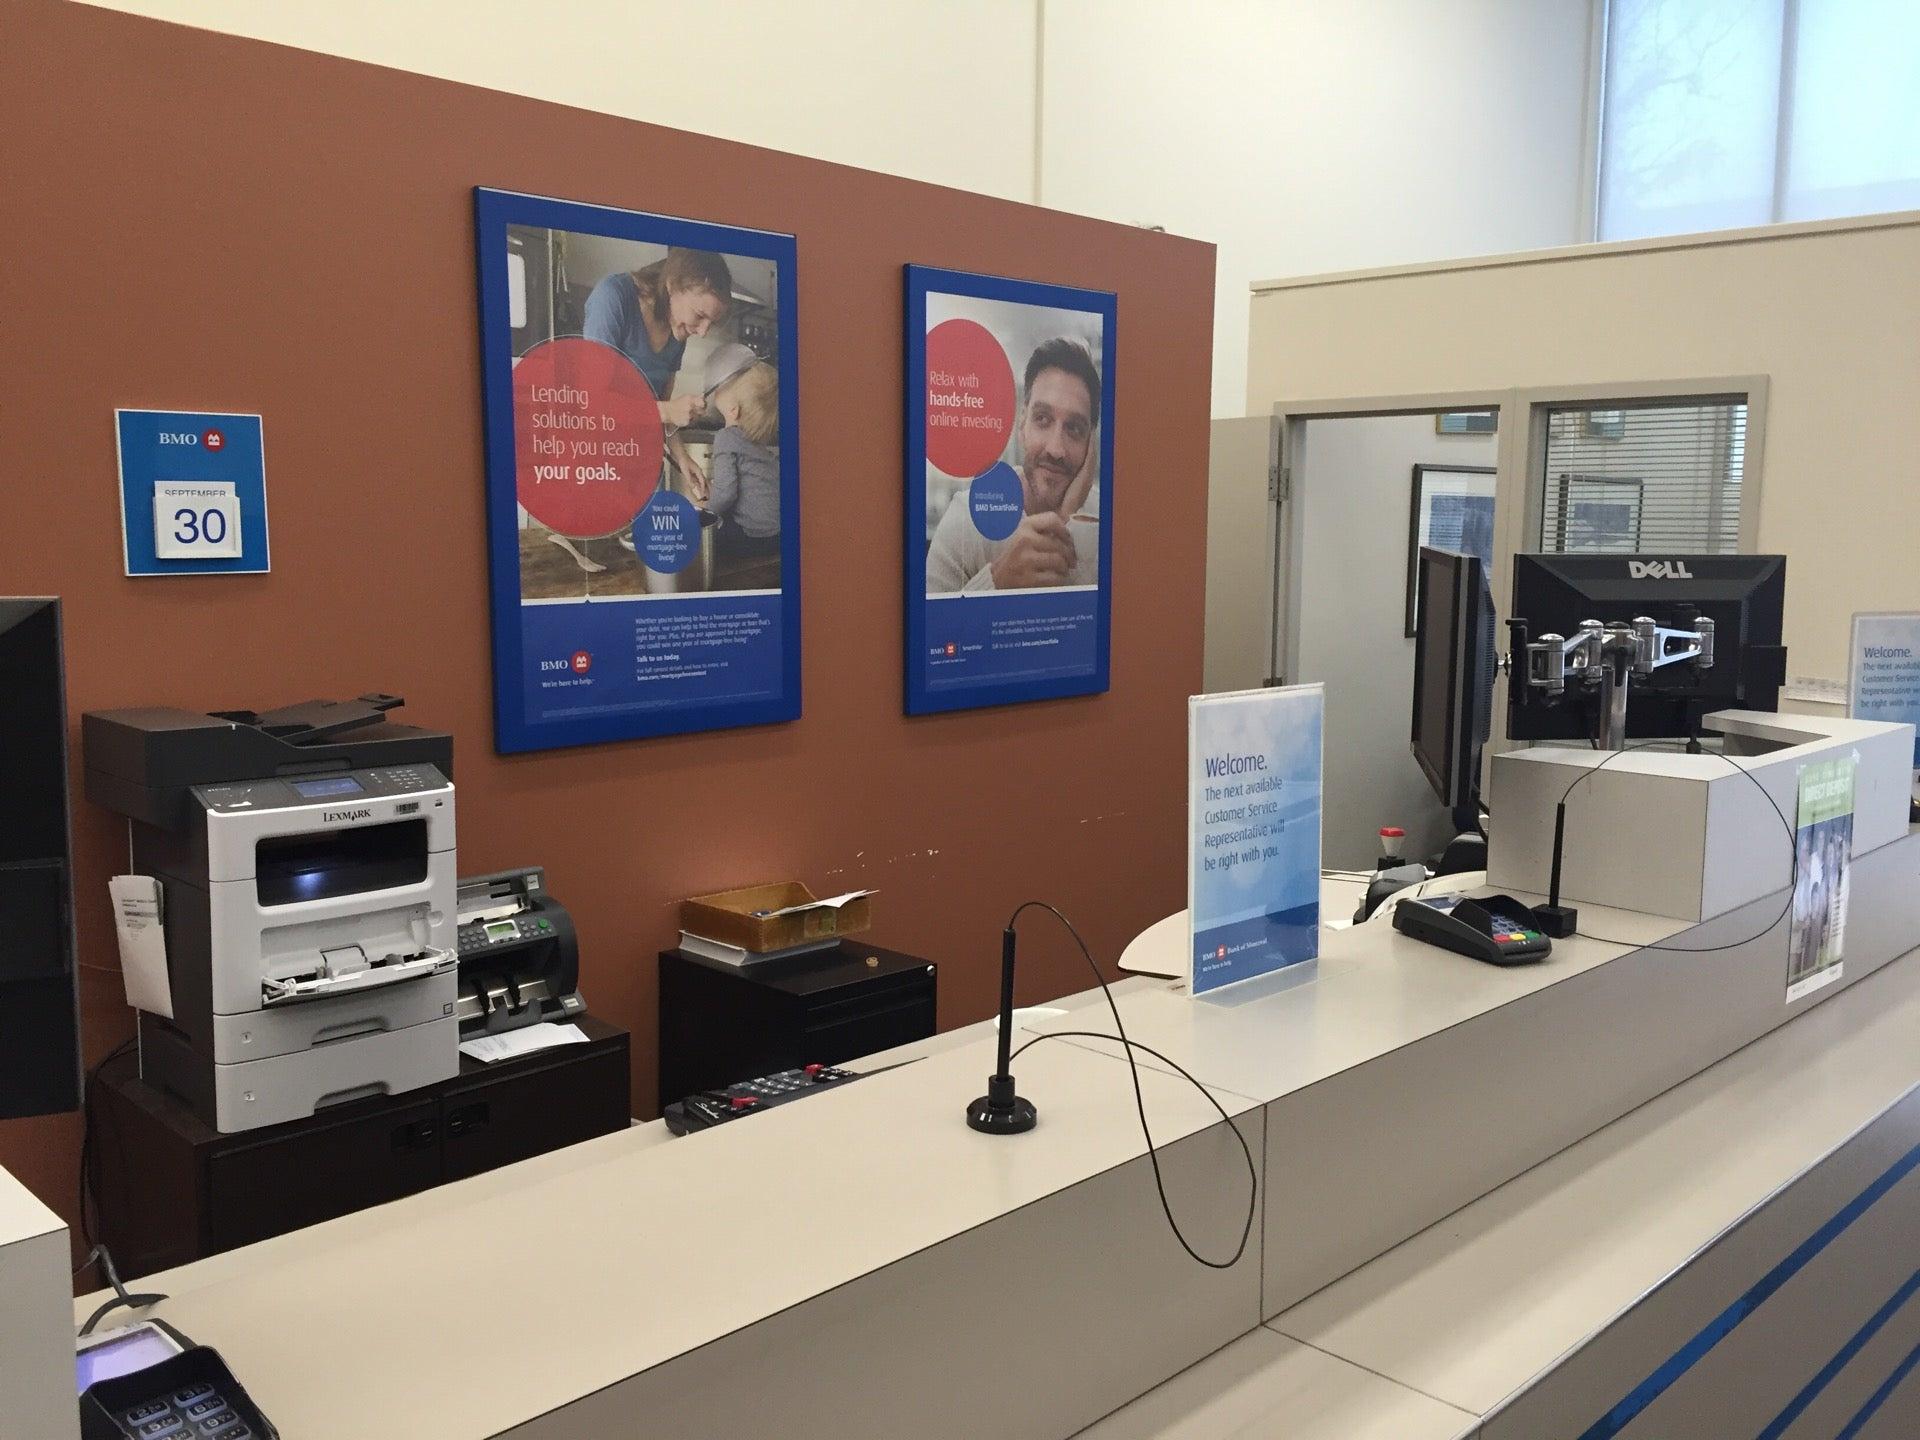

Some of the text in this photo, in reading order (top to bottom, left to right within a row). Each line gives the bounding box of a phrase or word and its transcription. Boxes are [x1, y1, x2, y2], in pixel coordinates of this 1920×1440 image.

[930, 371, 979, 388] Relax with
[532, 385, 588, 409] Lending
[930, 390, 984, 408] hands-free
[533, 410, 615, 431] solutions to
[930, 412, 1003, 432] online investing.
[159, 433, 197, 445] BMO
[534, 434, 639, 459] help you reach
[534, 462, 621, 484] your goals.
[990, 504, 1019, 512] SmartFolio
[174, 509, 226, 543] 30
[652, 516, 680, 530] WIN
[1628, 560, 1693, 579] DELL
[1864, 646, 1912, 658] Welcome.
[541, 660, 568, 670] BMO
[1863, 662, 1875, 670] The
[1206, 753, 1268, 778] Welcome.
[1205, 776, 1282, 801] The next available
[324, 809, 371, 822] LEXMARK
[1205, 801, 1278, 824] Customer Service
[1205, 819, 1284, 849] Representative will
[1205, 857, 1215, 871] be
[1219, 852, 1238, 870] right
[1241, 846, 1260, 862] with
[1203, 952, 1215, 961] BMO
[1227, 945, 1239, 954] Bank
